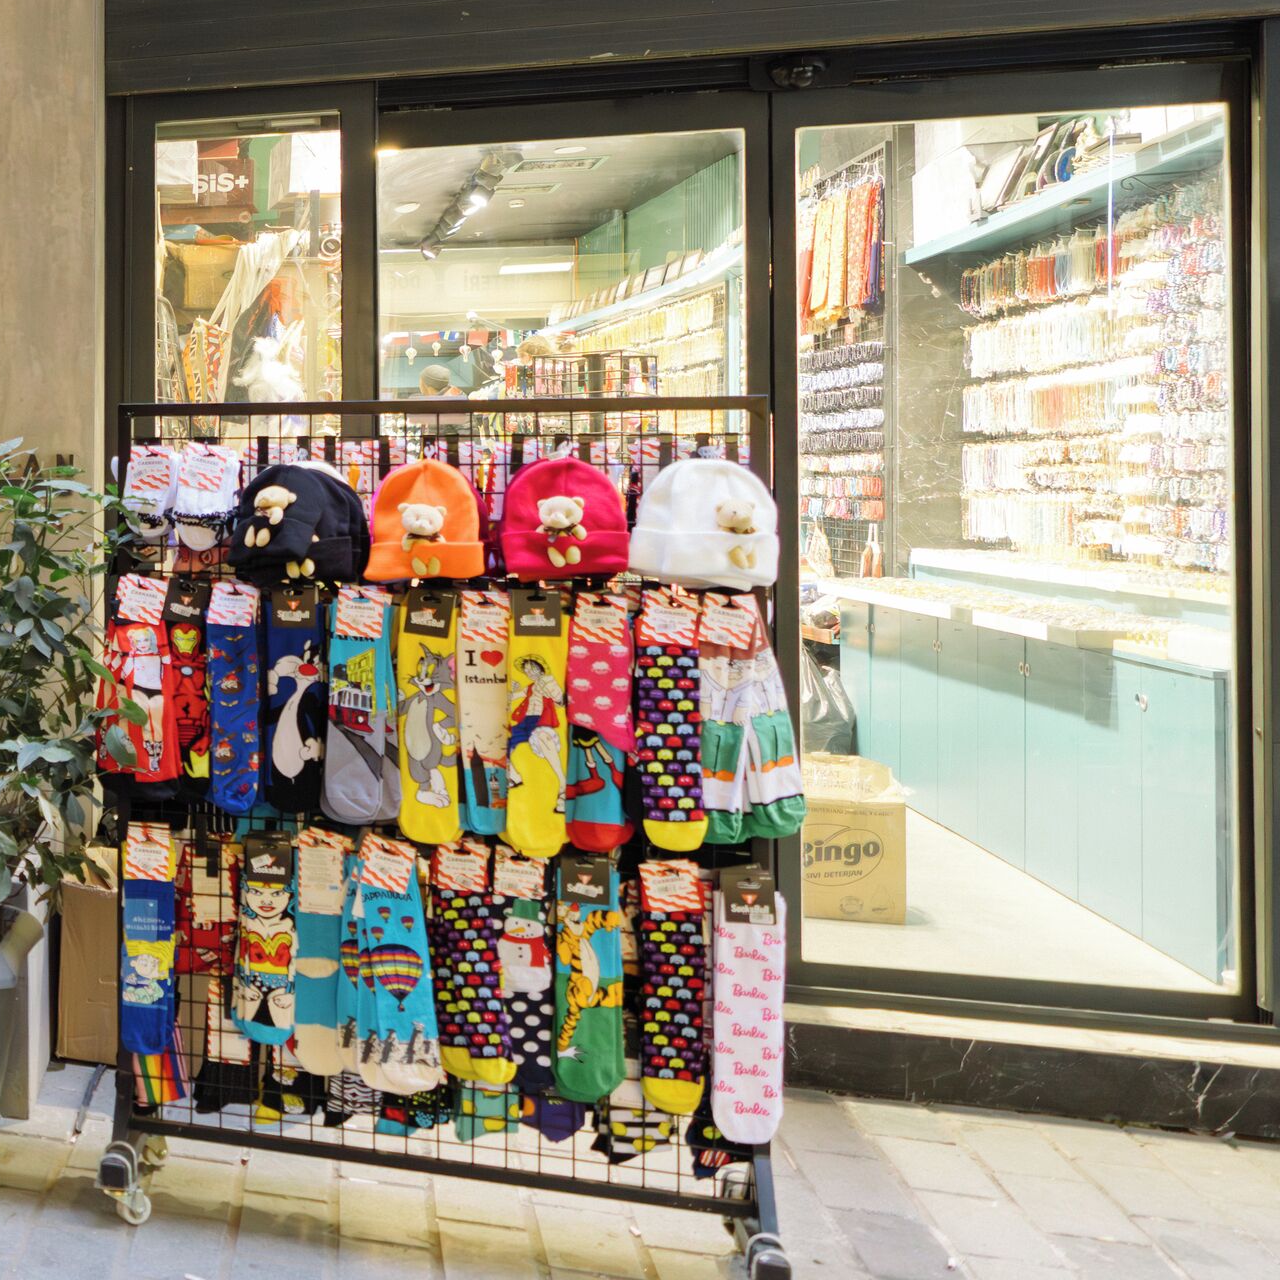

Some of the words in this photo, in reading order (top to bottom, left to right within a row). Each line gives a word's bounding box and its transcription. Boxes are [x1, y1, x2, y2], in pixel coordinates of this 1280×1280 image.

[465, 650, 478, 666] I
[734, 945, 768, 962] Barbie
[732, 983, 768, 1001] Barbie
[731, 1023, 768, 1040] Barbie
[733, 1061, 769, 1078] Barbie
[734, 1100, 770, 1116] Barbie
